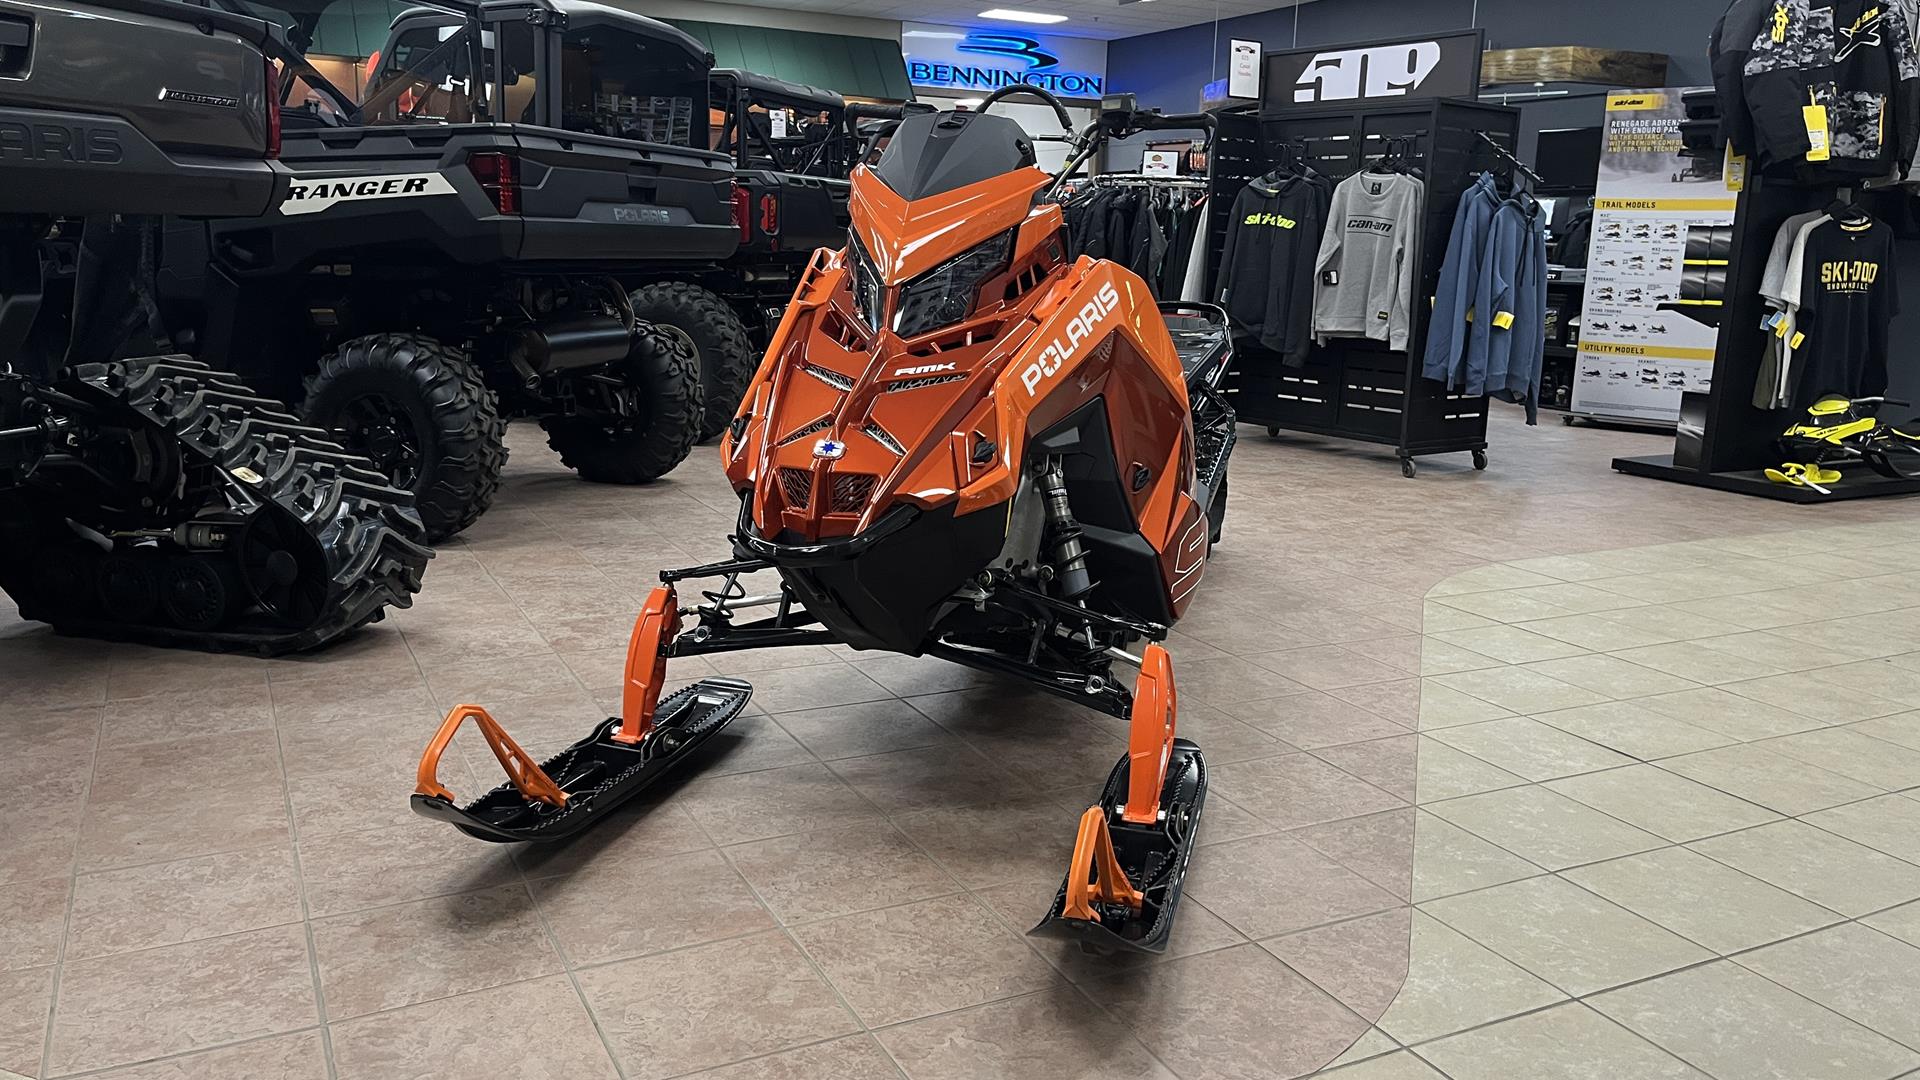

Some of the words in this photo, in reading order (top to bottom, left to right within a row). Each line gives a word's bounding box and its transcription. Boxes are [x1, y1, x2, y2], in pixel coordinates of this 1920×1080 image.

[911, 62, 1102, 94] BENNINGTON
[1294, 41, 1441, 103] 509
[1610, 127, 1630, 135] WITH
[1632, 126, 1661, 134] ENDURO
[1663, 126, 1681, 134] PAC
[1611, 119, 1650, 128] RENEGADE
[285, 177, 429, 201] RANGER
[1602, 201, 1622, 209] TRAIL
[1626, 201, 1656, 209] MODELS
[613, 207, 670, 224] POLARIS
[1347, 219, 1393, 233] can-am
[1020, 280, 1119, 397] POLARIS
[1584, 343, 1612, 353] UTILITY
[1615, 346, 1645, 355] MODELS
[894, 362, 956, 377] RMK
